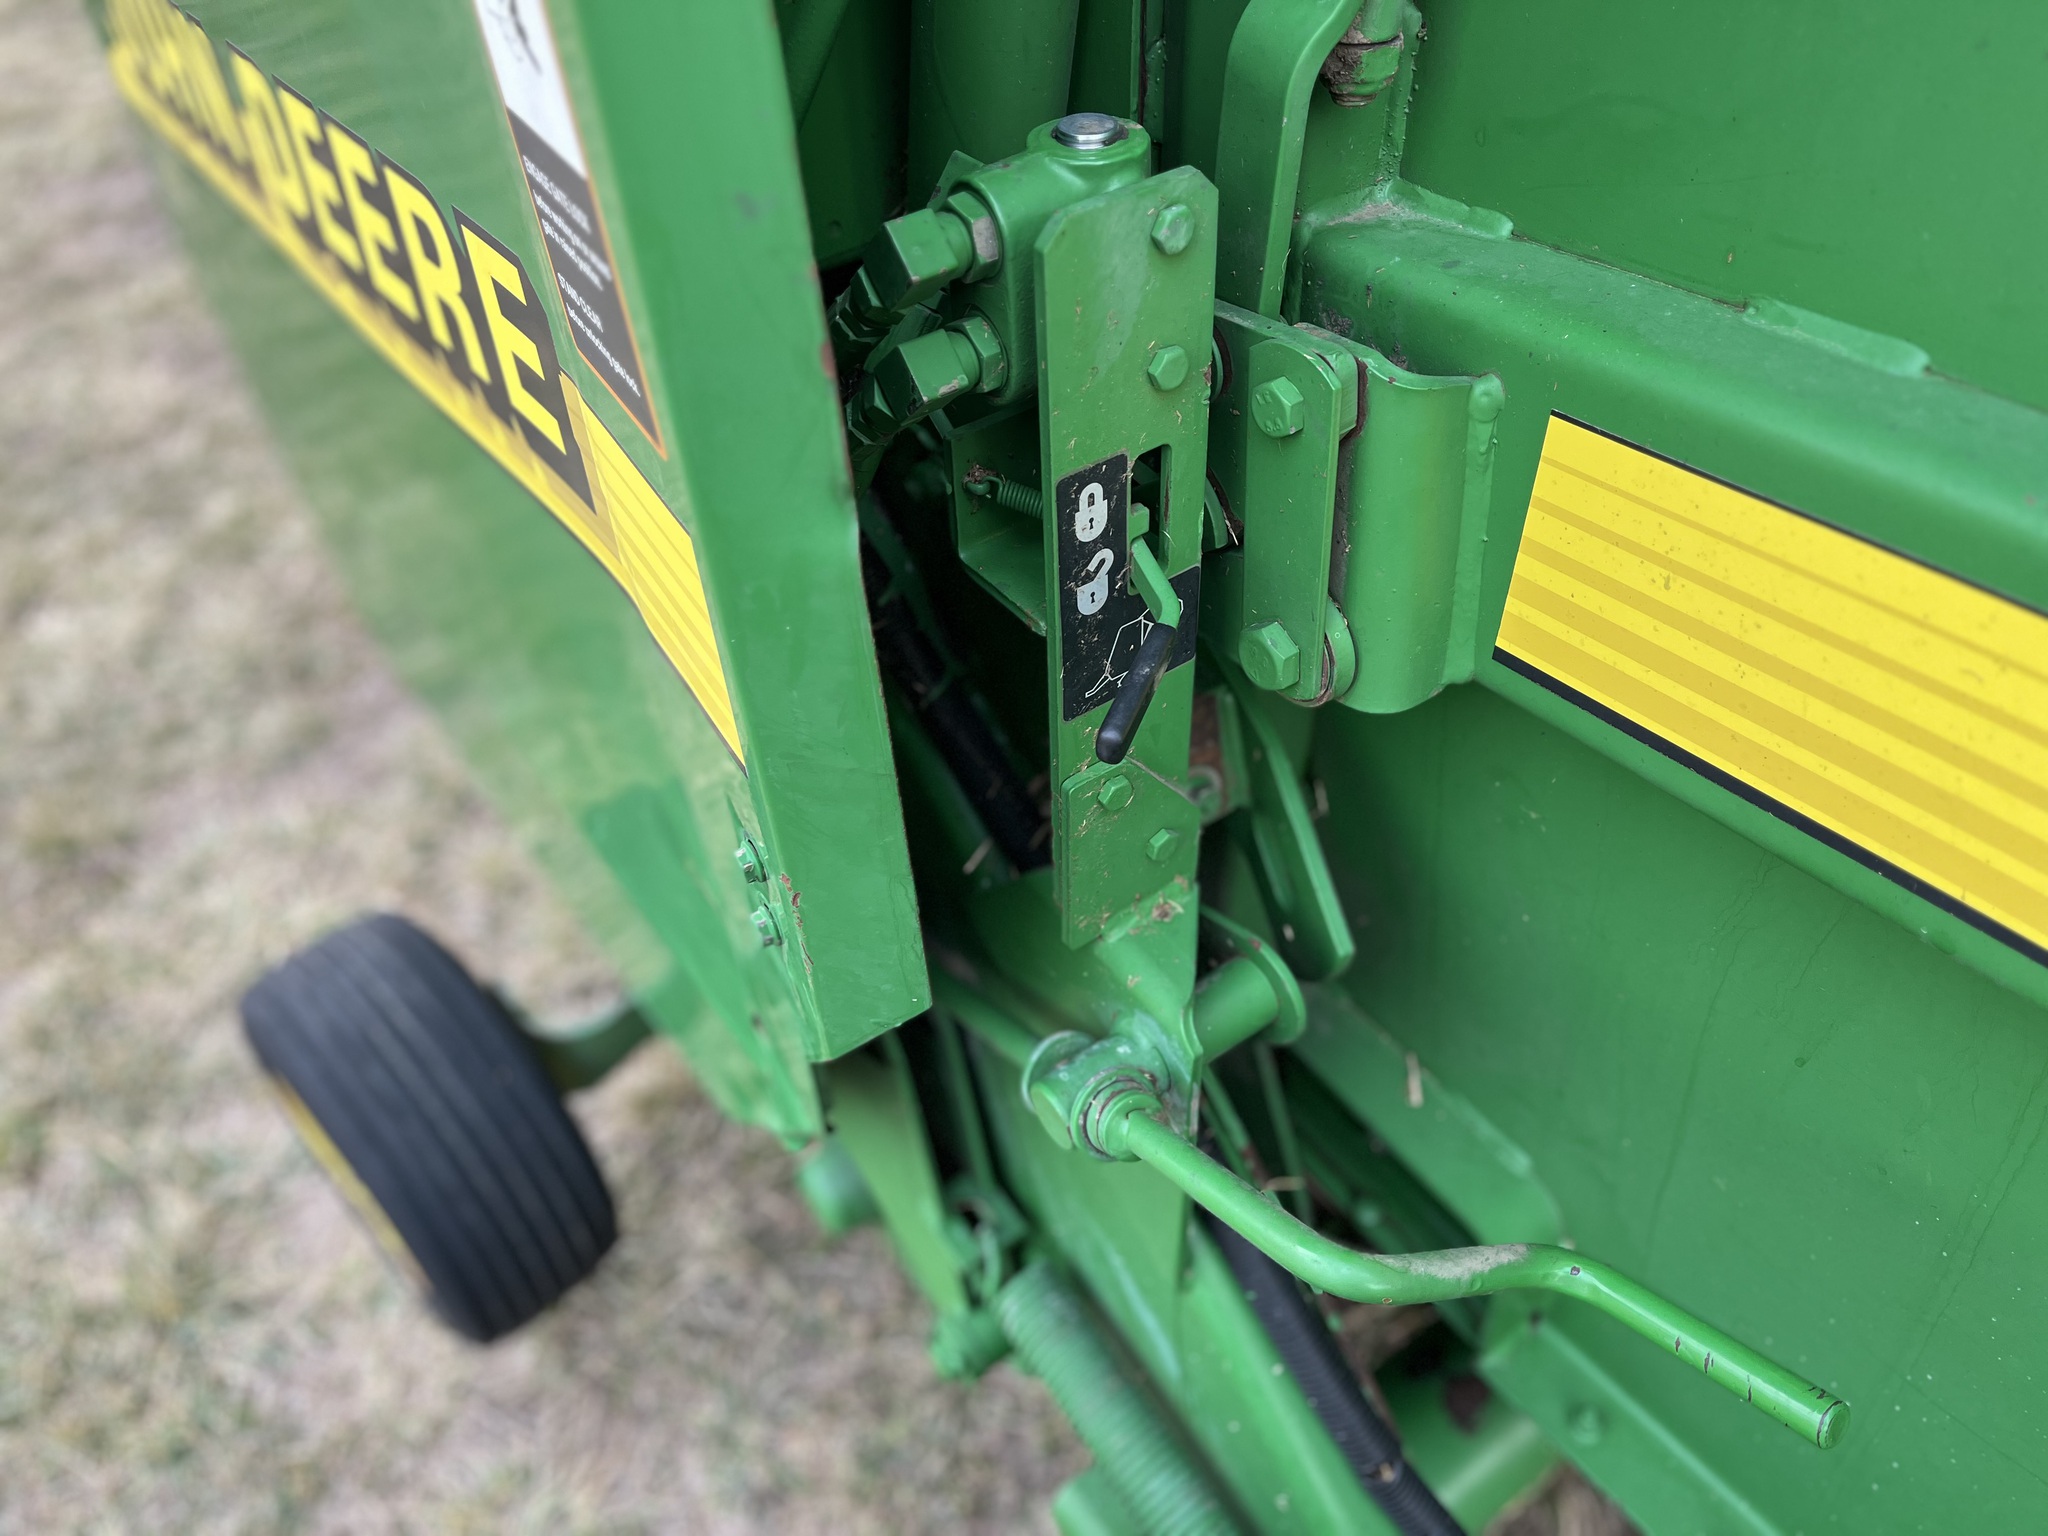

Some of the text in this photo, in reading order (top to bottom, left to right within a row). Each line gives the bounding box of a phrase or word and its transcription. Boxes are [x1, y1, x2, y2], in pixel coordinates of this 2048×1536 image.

[230, 50, 567, 456] DEERE
[558, 272, 580, 306] STAND
[579, 296, 603, 333] CLEAR
